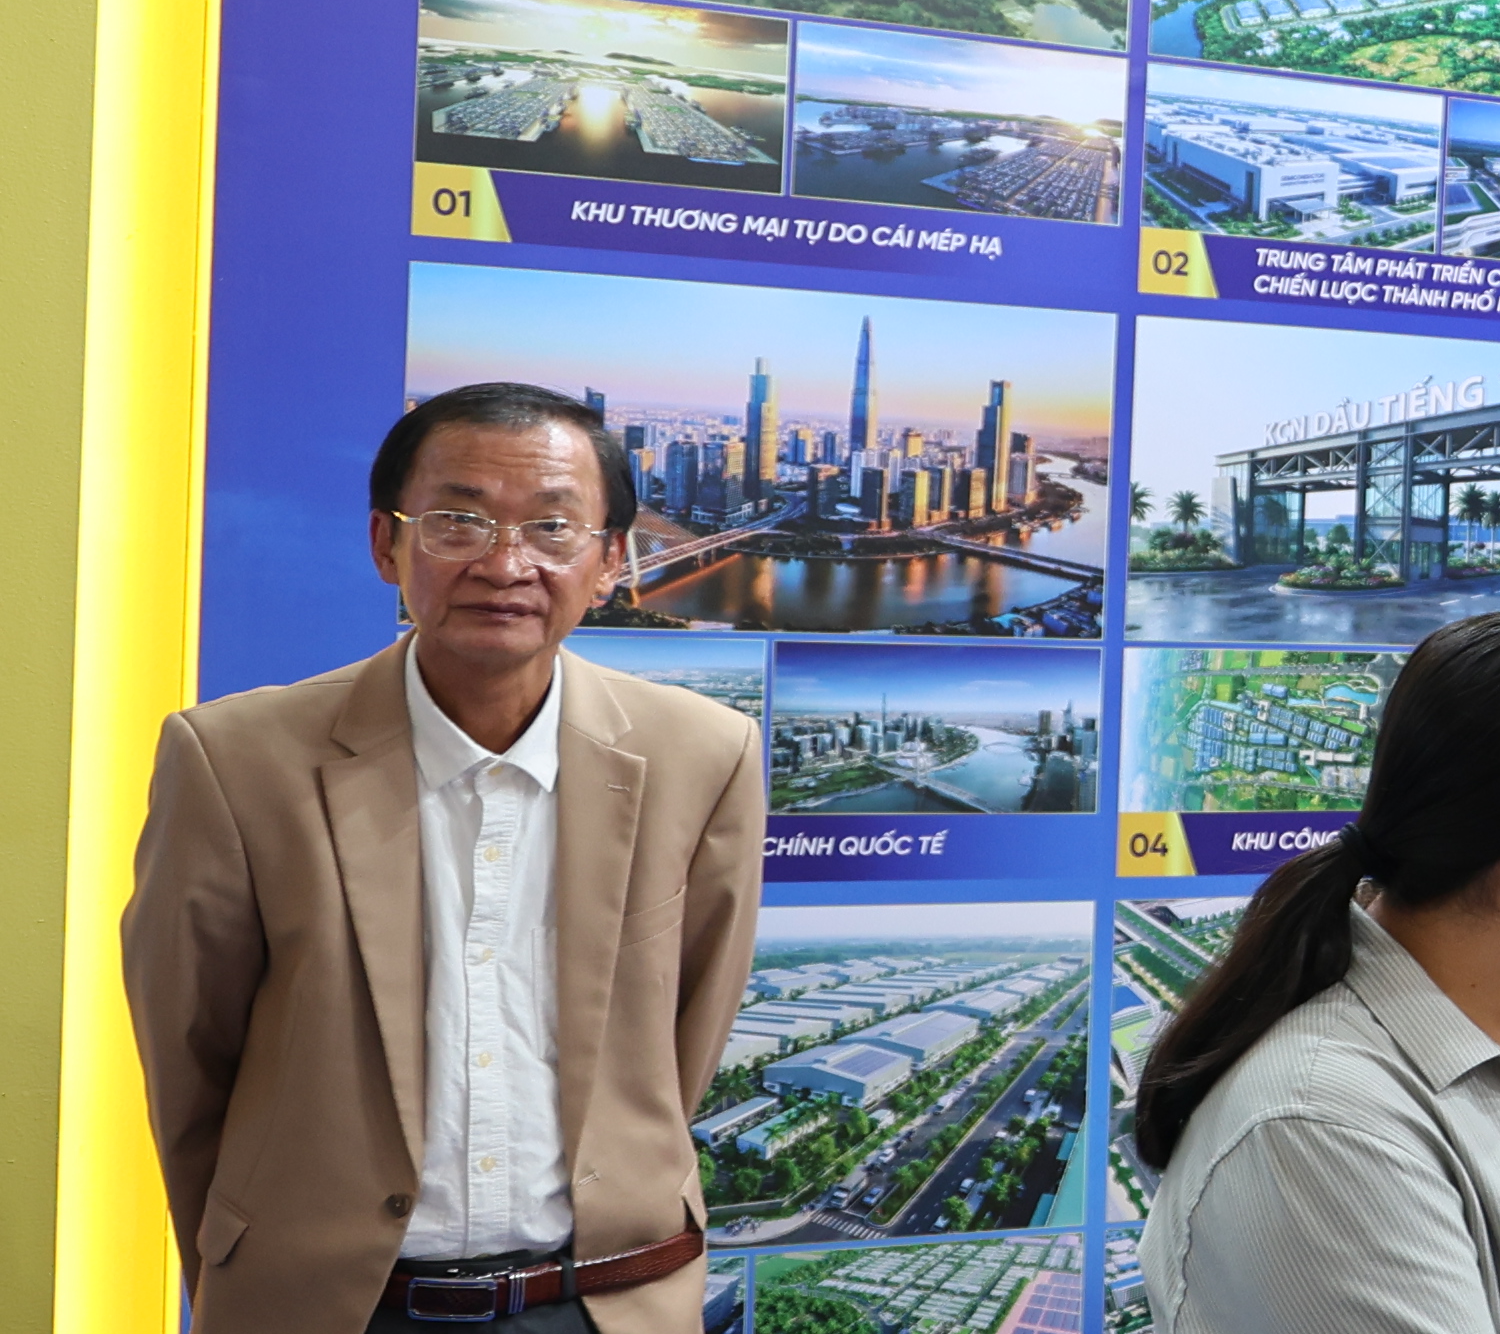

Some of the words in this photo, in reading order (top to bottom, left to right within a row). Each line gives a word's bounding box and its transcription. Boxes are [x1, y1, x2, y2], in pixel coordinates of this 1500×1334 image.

[432, 188, 472, 218] 01
[571, 200, 626, 225] KHU
[629, 204, 738, 236] THƯƠNG
[742, 215, 786, 246] MẠI
[794, 219, 828, 247] TỰ
[829, 223, 869, 247] DO
[872, 222, 914, 249] CÁI
[918, 227, 966, 254] MÉP
[968, 234, 1002, 261] HẠ
[1152, 249, 1189, 277] 02
[1254, 248, 1326, 272] TRUNG
[1331, 251, 1374, 276] TÂM
[1376, 255, 1428, 280] PHÁT
[1252, 272, 1317, 297] CHIẾN
[1320, 280, 1379, 307] LƯỢC
[1382, 282, 1448, 309] THÀNH
[1451, 285, 1494, 312] PHỐ
[1263, 416, 1308, 445] KCN
[1379, 374, 1484, 424] TIẾNG
[762, 831, 834, 857] CHÍNH
[839, 831, 912, 858] QUỐC
[918, 829, 948, 855] TẾ
[1129, 833, 1168, 857] 04
[1232, 831, 1277, 851] KHU
